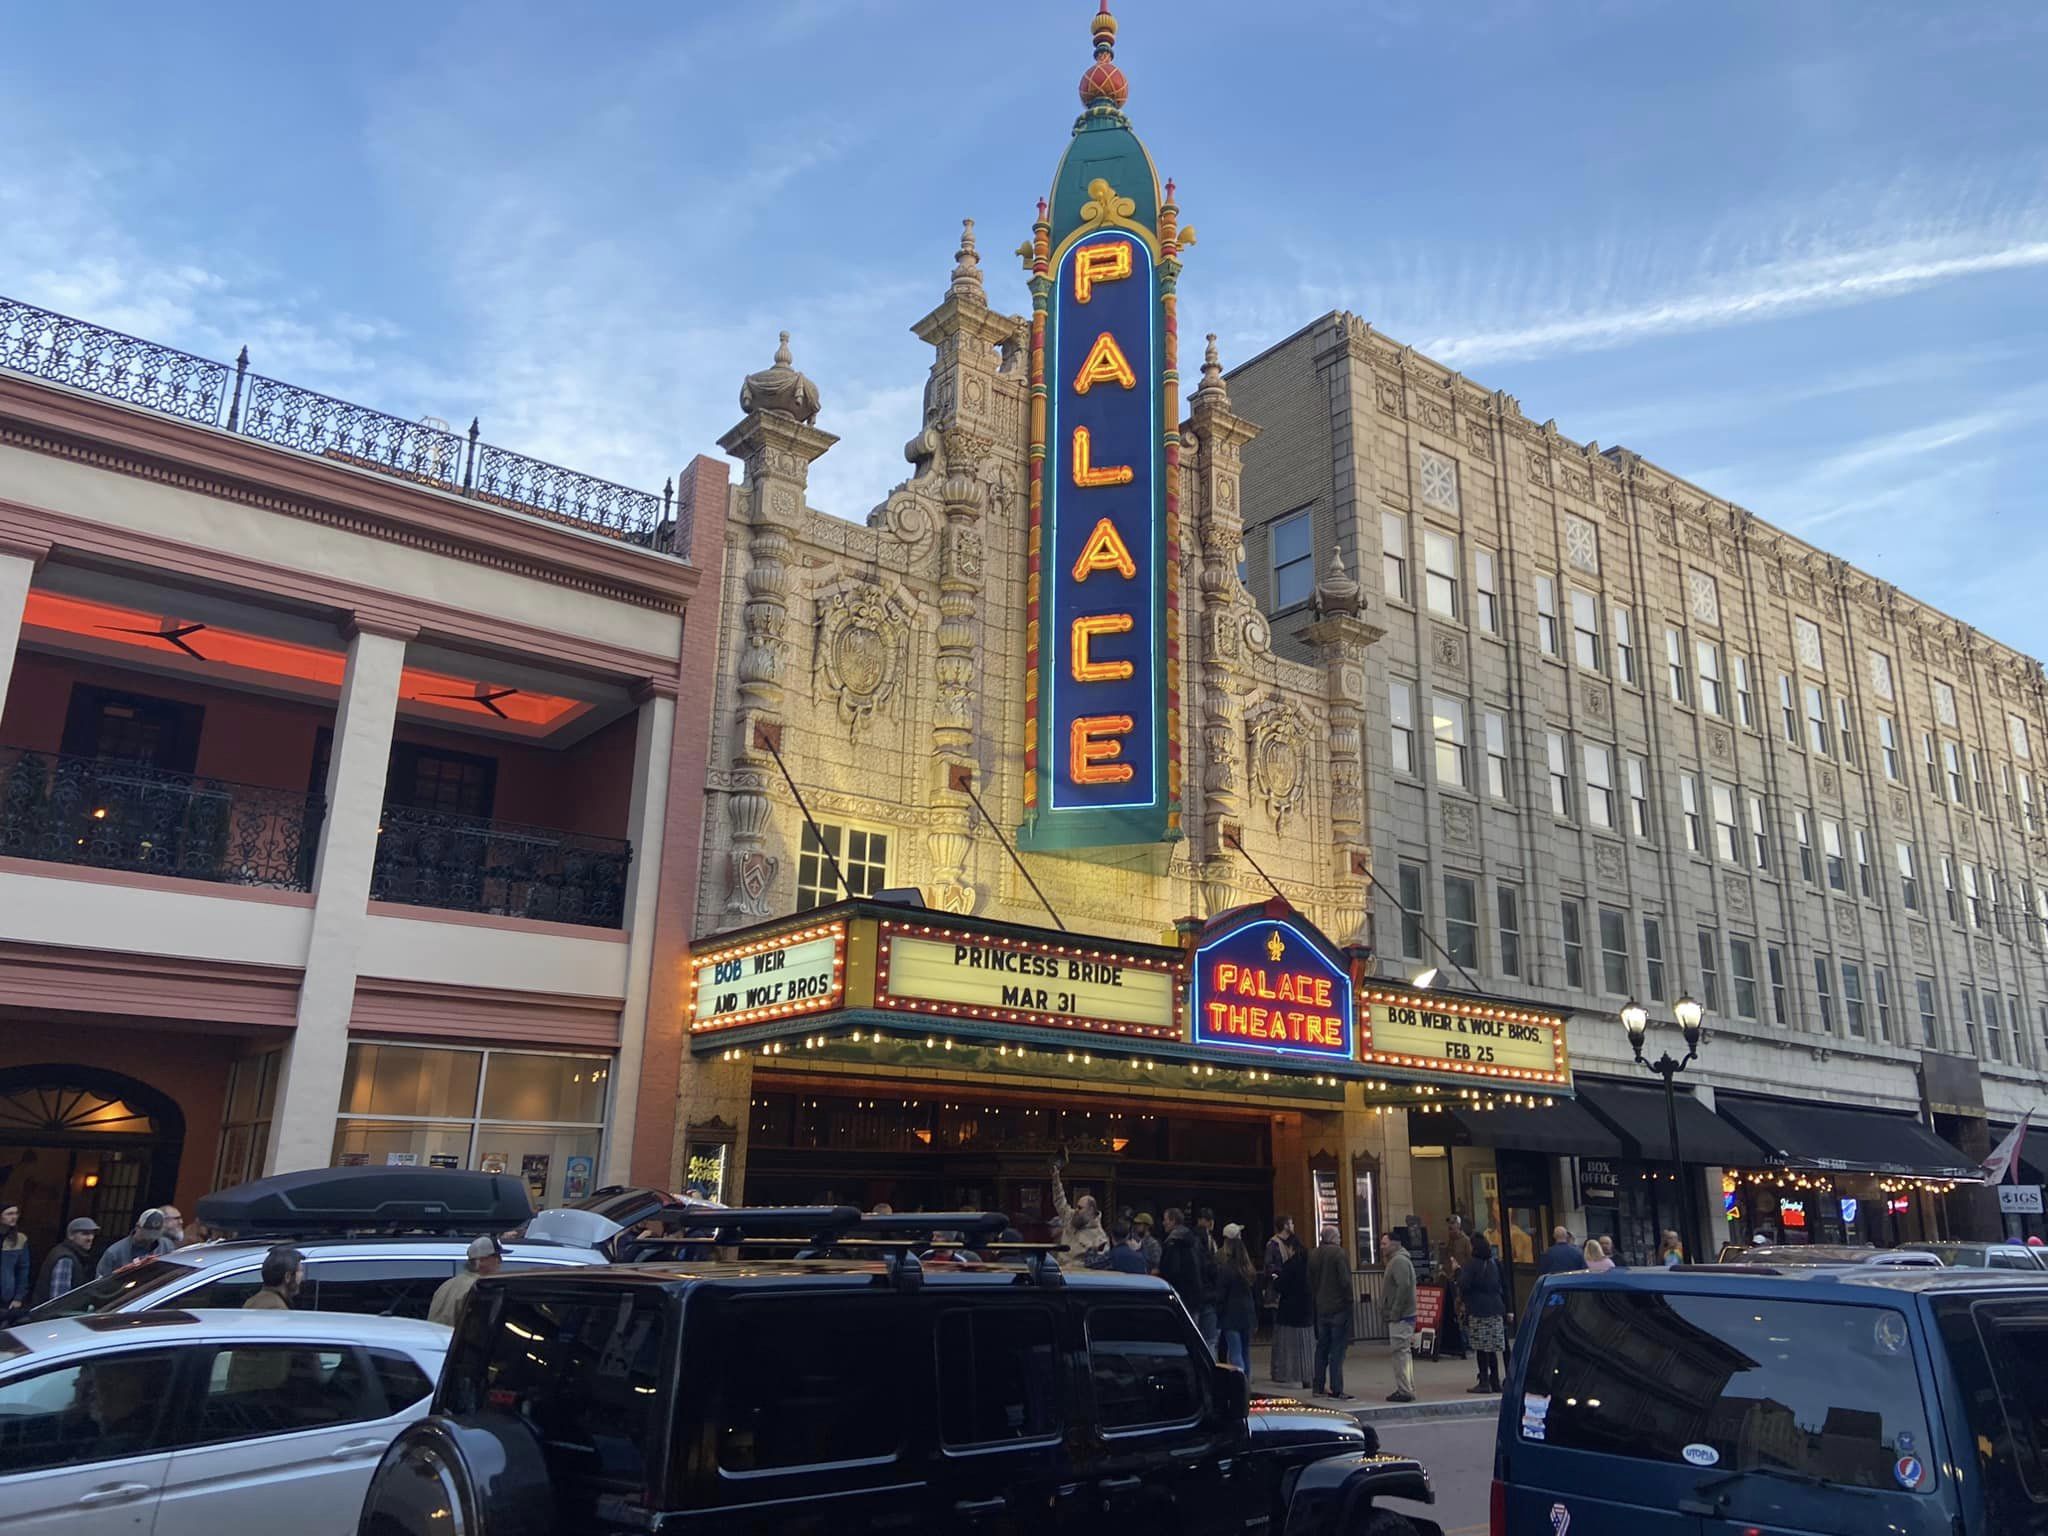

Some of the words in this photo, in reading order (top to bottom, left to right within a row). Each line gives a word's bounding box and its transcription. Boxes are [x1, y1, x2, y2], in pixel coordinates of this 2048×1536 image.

[1070, 240, 1136, 785] PALACE
[714, 958, 742, 985] BOB
[754, 950, 786, 974] WEIR
[954, 945, 1059, 979] PRINCESS
[1068, 960, 1124, 987] BRIDE
[713, 993, 738, 1015] AND
[746, 983, 783, 1009] WOLF
[788, 974, 829, 1001] BROS
[1002, 986, 1048, 1010] MAR
[1058, 993, 1076, 1013] 31
[1216, 963, 1333, 1008] PALACE
[1208, 1002, 1343, 1046] THEATRE
[1388, 1006, 1416, 1026] BOB
[1421, 1011, 1452, 1032] WEIR
[1457, 1016, 1467, 1033] &
[1470, 1018, 1505, 1037] WOLF
[1508, 1024, 1543, 1044] BROS.
[1445, 1041, 1471, 1060] FEB
[1477, 1046, 1495, 1062] 25
[1581, 1171, 1619, 1186] OFFICE
[1587, 1161, 1610, 1173] BOX
